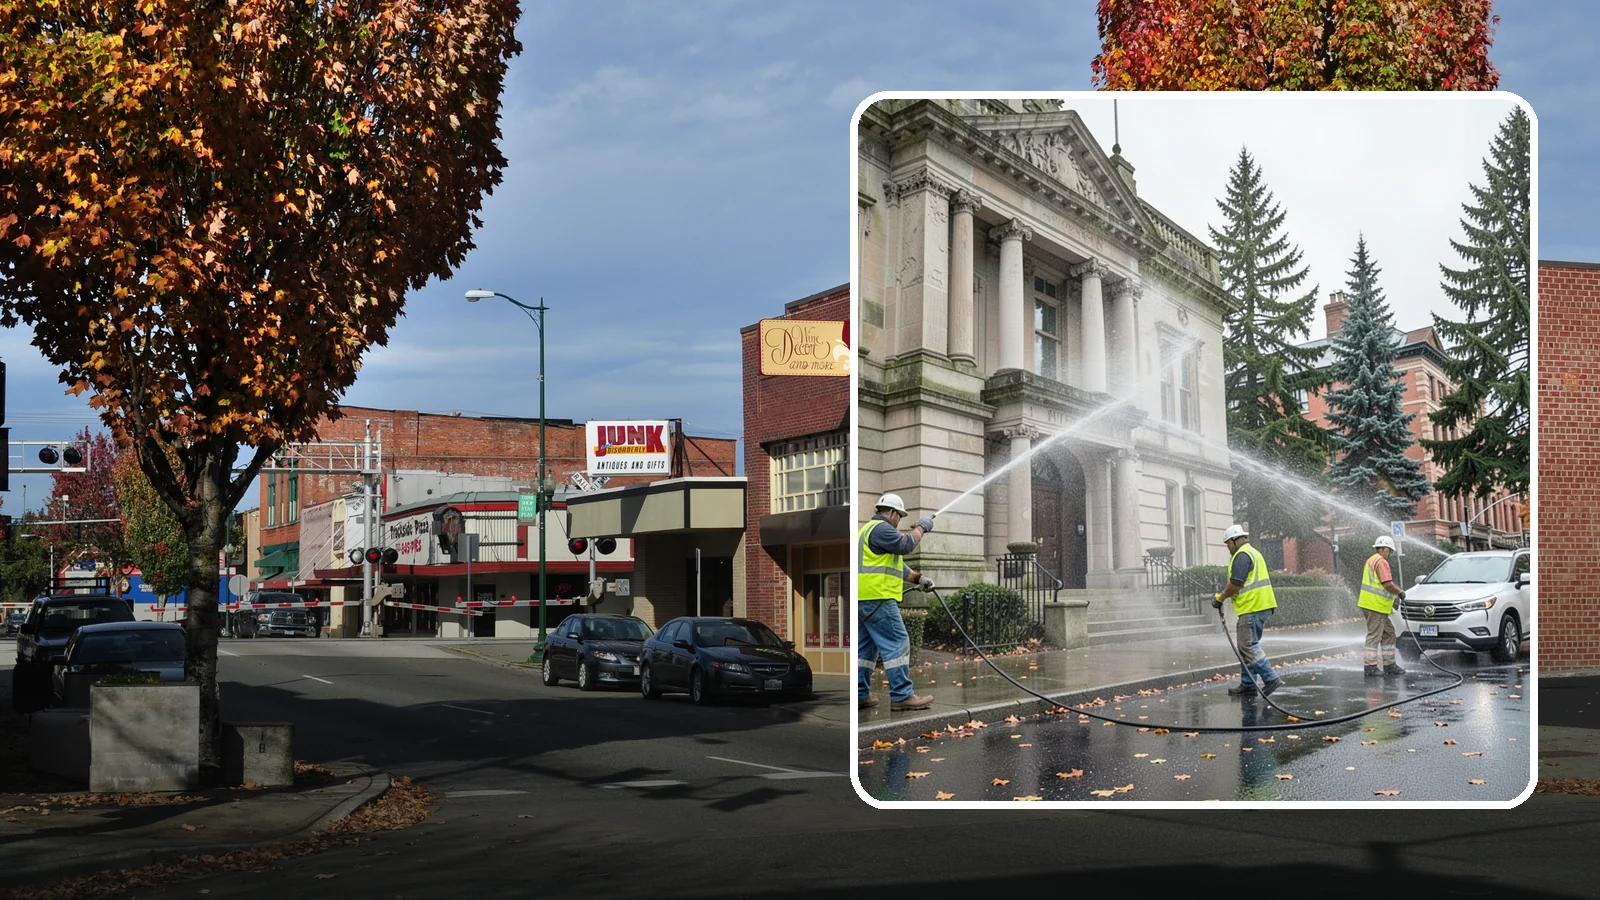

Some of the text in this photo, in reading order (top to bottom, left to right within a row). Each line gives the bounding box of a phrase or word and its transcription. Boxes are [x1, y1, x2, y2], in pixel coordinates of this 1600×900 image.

[595, 425, 665, 457] JUNK
[607, 446, 646, 454] DISORDERLY
[596, 460, 665, 470] ANTIQUES AND GIFTS
[414, 519, 429, 535] Pizza
